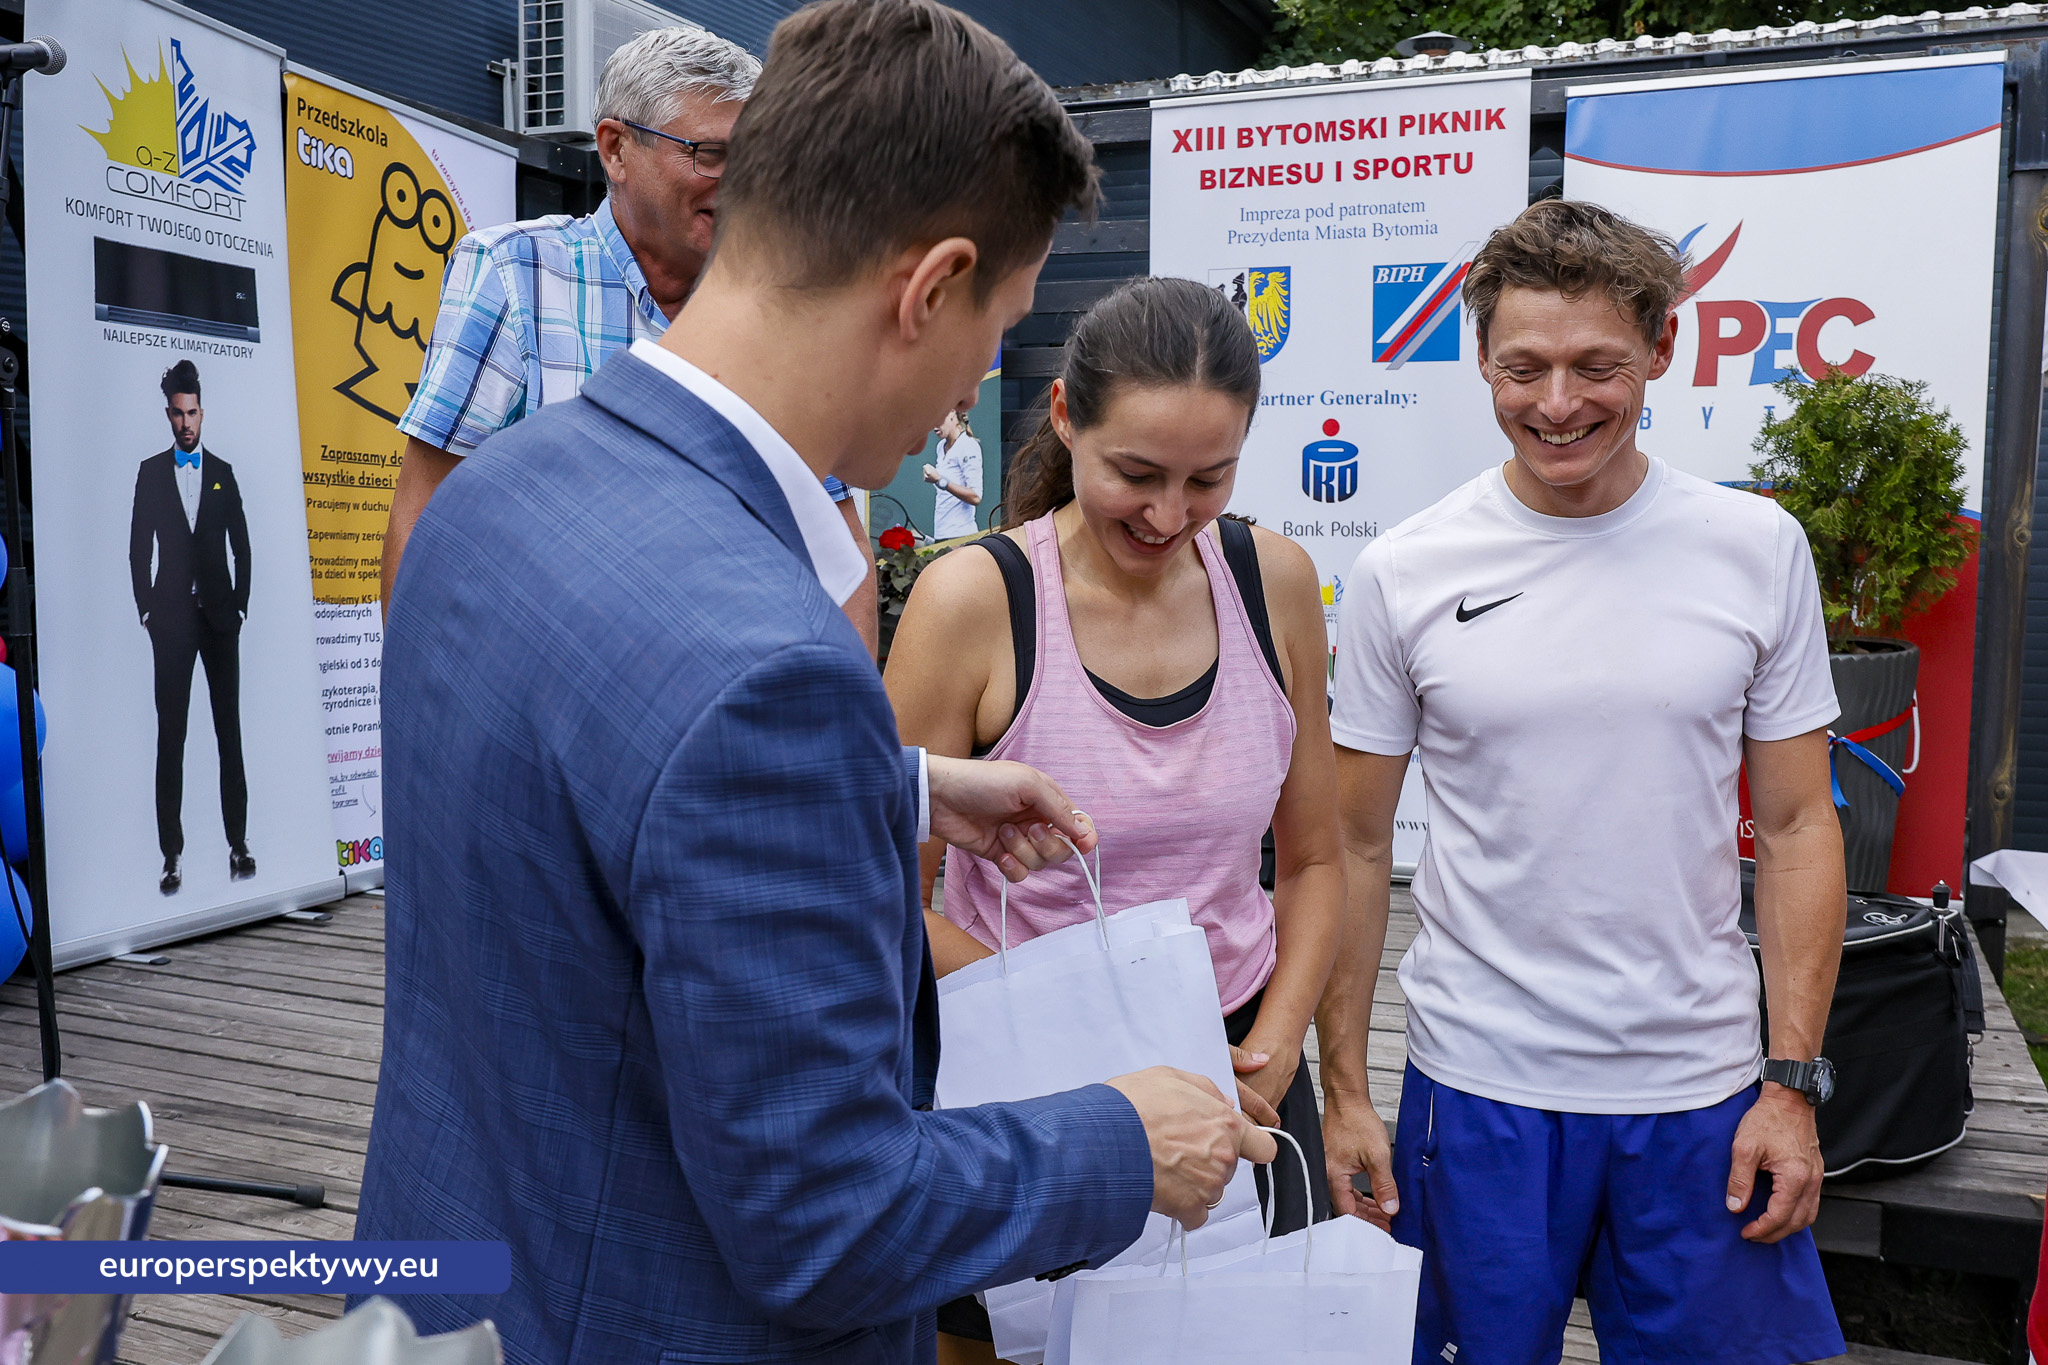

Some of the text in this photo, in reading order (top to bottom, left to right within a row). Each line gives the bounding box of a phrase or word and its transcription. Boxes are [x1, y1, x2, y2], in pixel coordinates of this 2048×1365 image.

[296, 96, 388, 148] Przedszkola
[1172, 107, 1507, 154] XIII BYTOMSKI PIKNIK
[1200, 151, 1474, 190] BIZNESU I SPORTU
[106, 165, 247, 219] COMFORT
[1240, 200, 1426, 225] Impreza pod patronatem
[65, 197, 274, 259] KOMFORT TWOJEGO OTOCZENIA
[1227, 219, 1439, 247] Prezydenta Miasta Bytomia
[1374, 265, 1428, 285] BIPH
[103, 328, 254, 360] NAJLEPSZE KLIMATYZATORY
[1692, 297, 1876, 388] PEC
[1259, 390, 1418, 409] artner Generalny:
[320, 444, 404, 469] Zapraszamy do
[302, 468, 356, 489] wszystkie
[358, 470, 393, 488] dzieci
[306, 497, 390, 513] Pracujemy w duchu
[307, 528, 361, 544] Zapewniamy
[1283, 520, 1378, 538] Bank Polski
[324, 568, 347, 580] dzieci
[314, 607, 372, 621] odopiecznych
[316, 633, 362, 646] rowadzimy
[350, 658, 362, 669] od
[364, 657, 370, 669] 3
[325, 724, 350, 736] otnie
